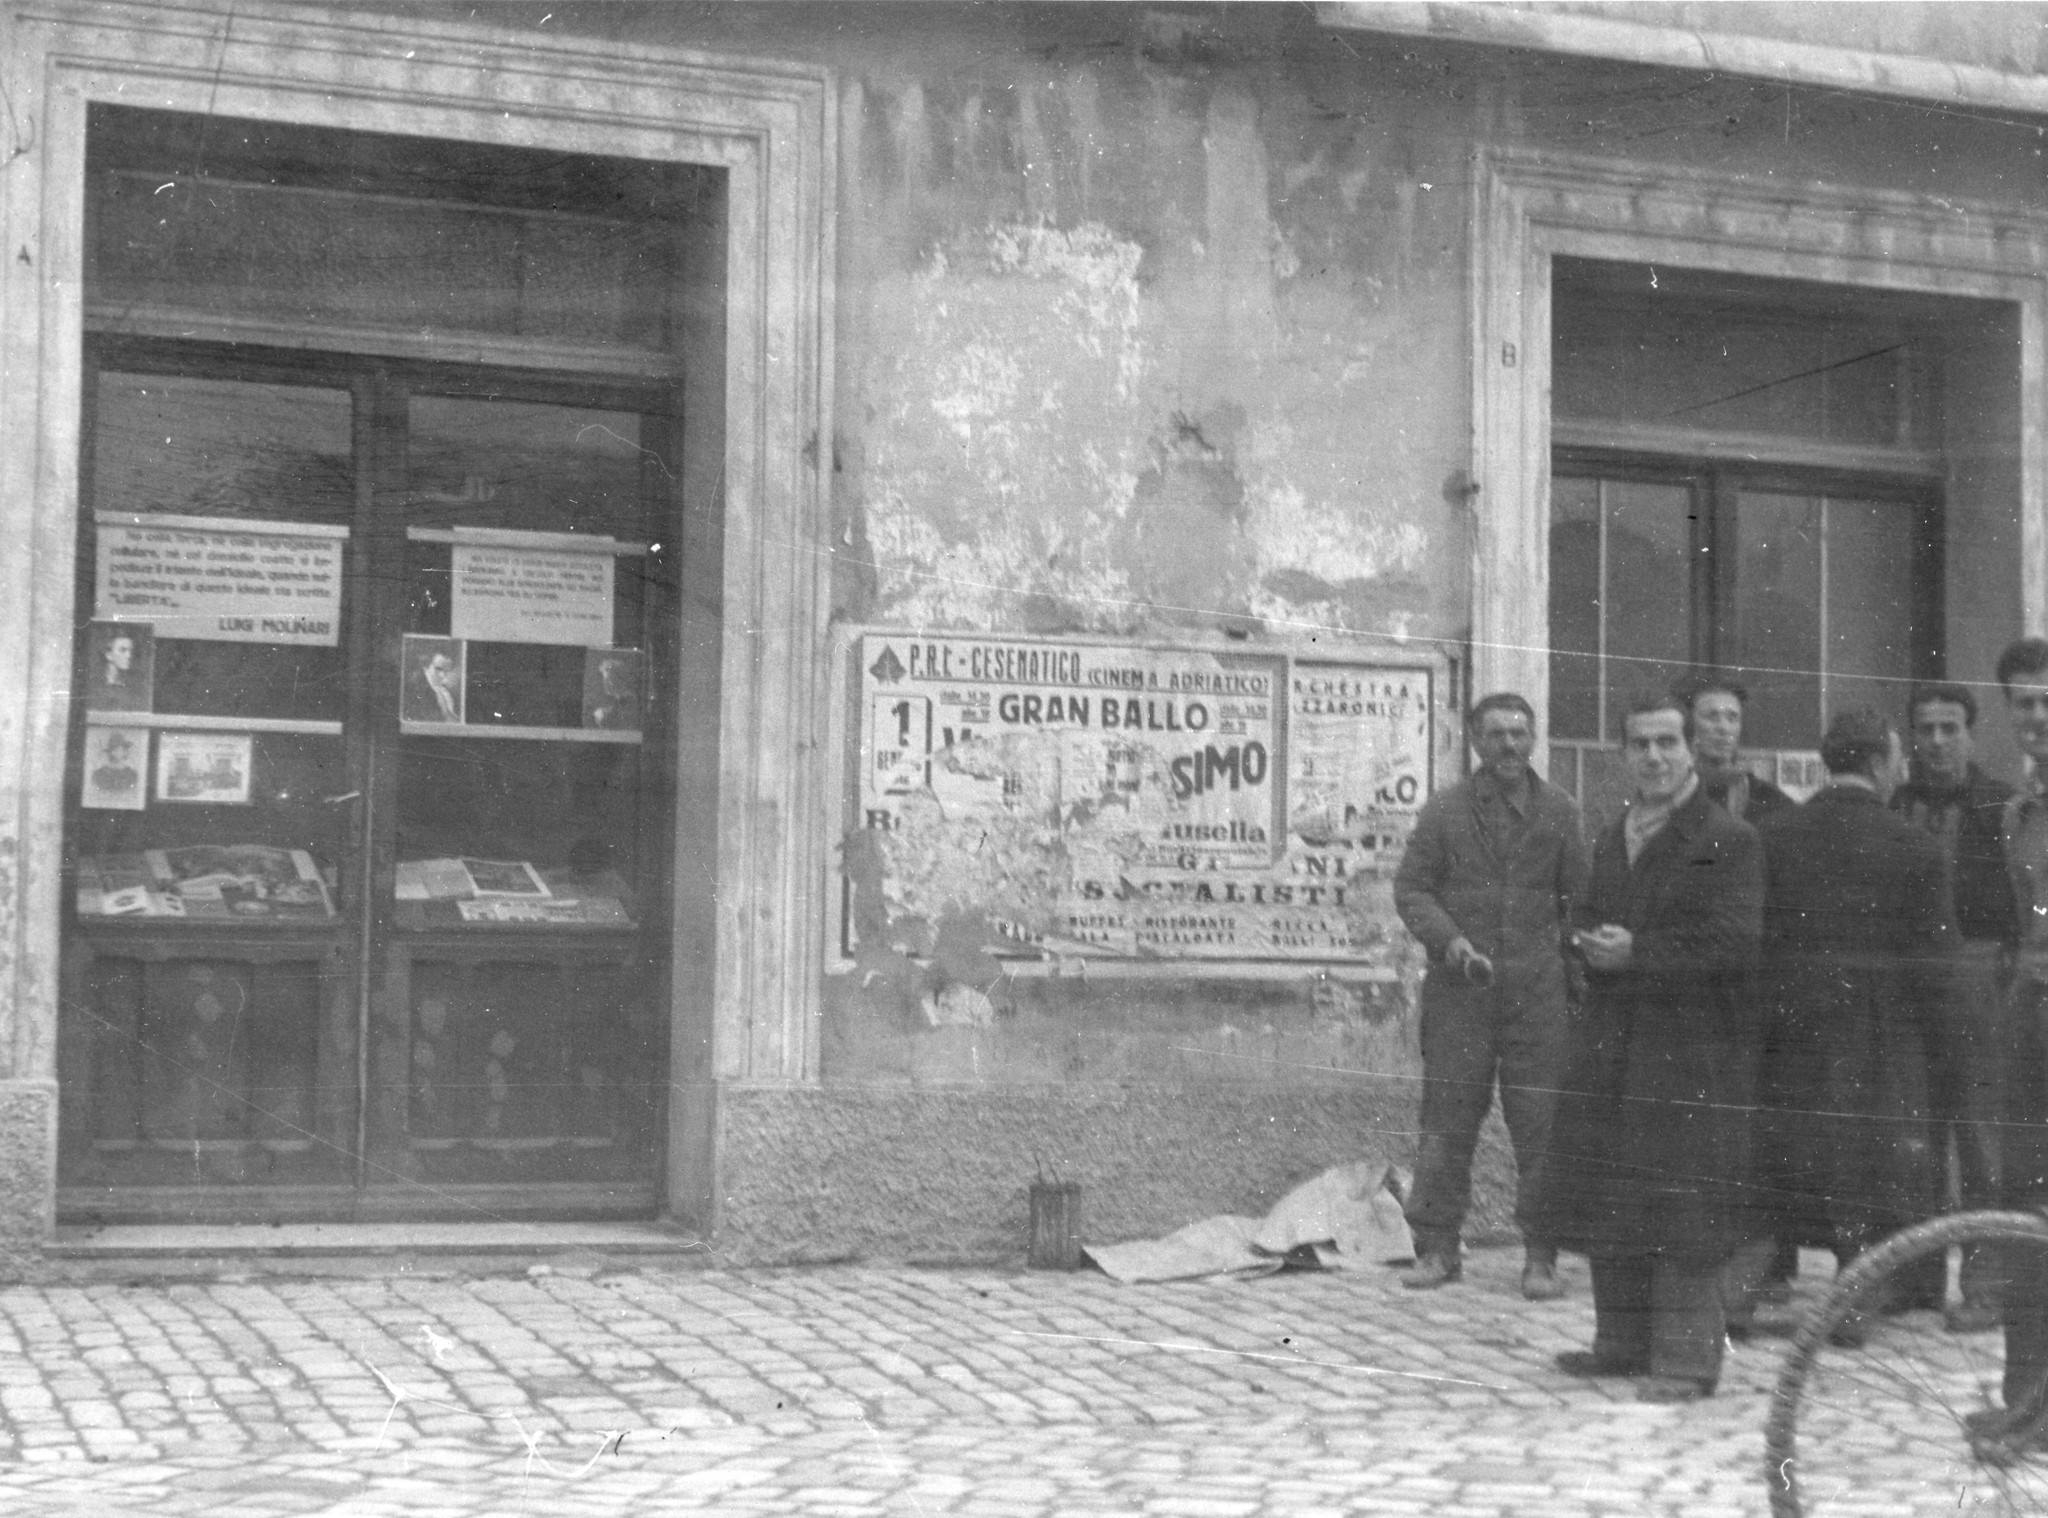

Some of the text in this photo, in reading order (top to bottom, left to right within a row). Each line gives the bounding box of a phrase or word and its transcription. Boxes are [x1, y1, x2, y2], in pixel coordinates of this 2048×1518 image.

[219, 618, 330, 635] LUIGI MOLINARI
[971, 647, 1080, 684] CESENATICO
[999, 694, 1209, 731] GRAN BALLO
[1171, 741, 1267, 801] SIMO
[1145, 916, 1235, 929] RISTORANTE
